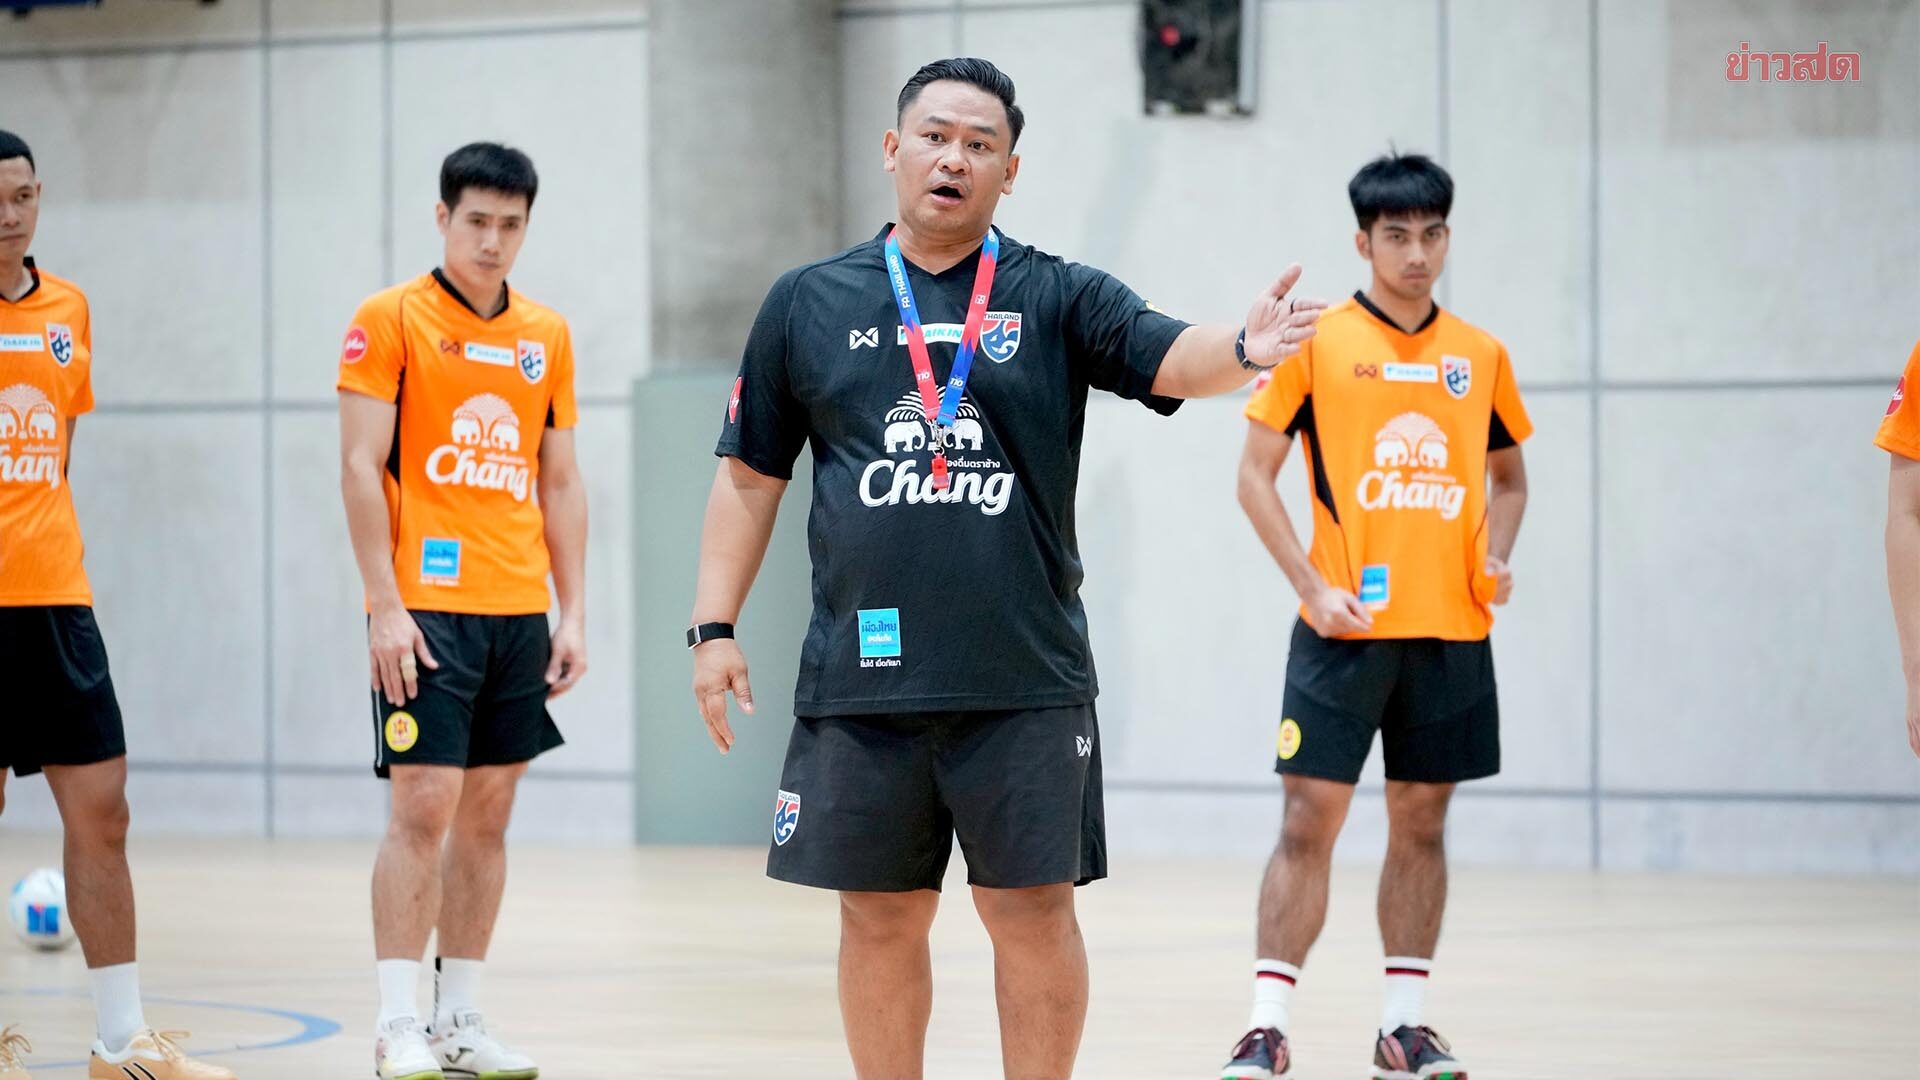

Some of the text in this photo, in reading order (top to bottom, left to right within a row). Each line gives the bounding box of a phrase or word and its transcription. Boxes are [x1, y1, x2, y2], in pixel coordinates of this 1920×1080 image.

[890, 254, 907, 296] THAILAND
[925, 328, 963, 338] AIKIN
[984, 313, 1020, 321] THAILAND
[0, 444, 60, 490] hang
[425, 444, 529, 502] Chang
[944, 455, 1001, 469] องดื่มตราช้าง
[858, 459, 1016, 516] Chang
[1357, 470, 1467, 521] Chang
[861, 620, 897, 633] เมืองไทย
